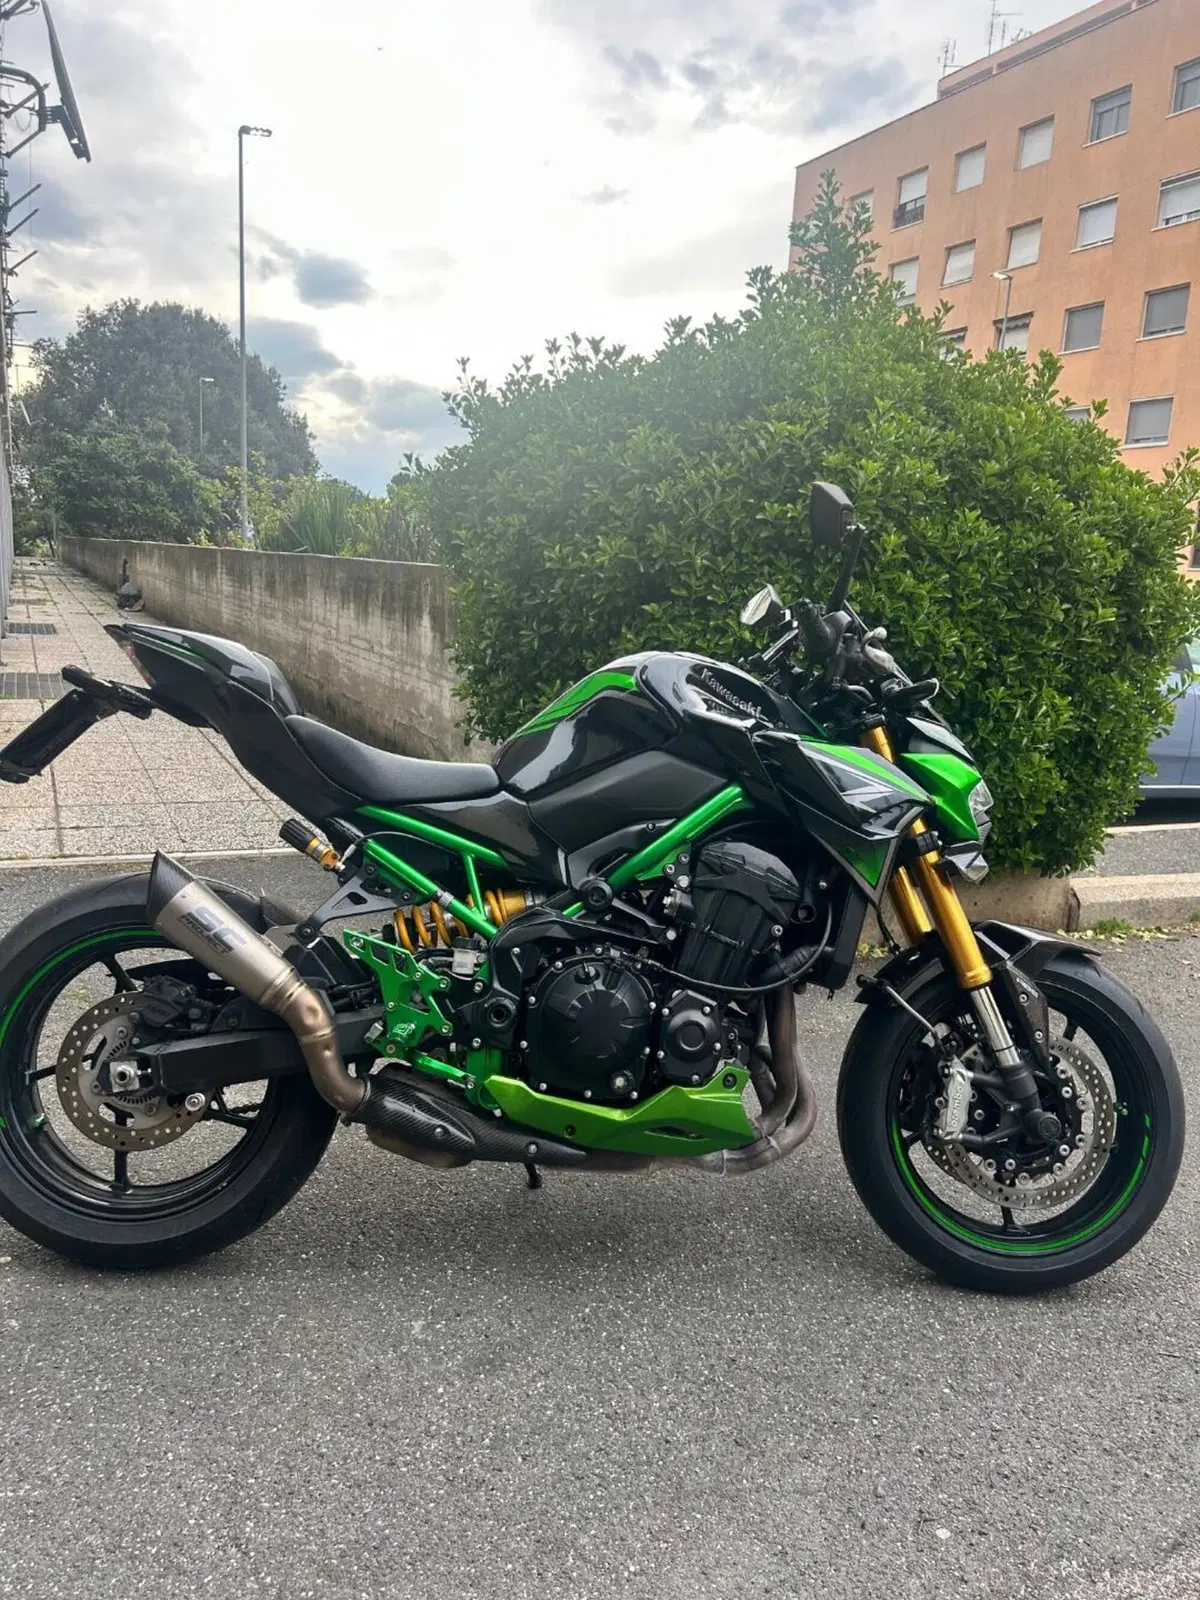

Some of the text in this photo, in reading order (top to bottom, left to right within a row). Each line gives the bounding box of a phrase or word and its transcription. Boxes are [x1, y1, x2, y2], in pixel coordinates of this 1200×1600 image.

[701, 668, 762, 719] Kawasaki
[177, 914, 230, 953] PROJECT
[187, 907, 247, 952] SC
[949, 1086, 964, 1127] brembo
